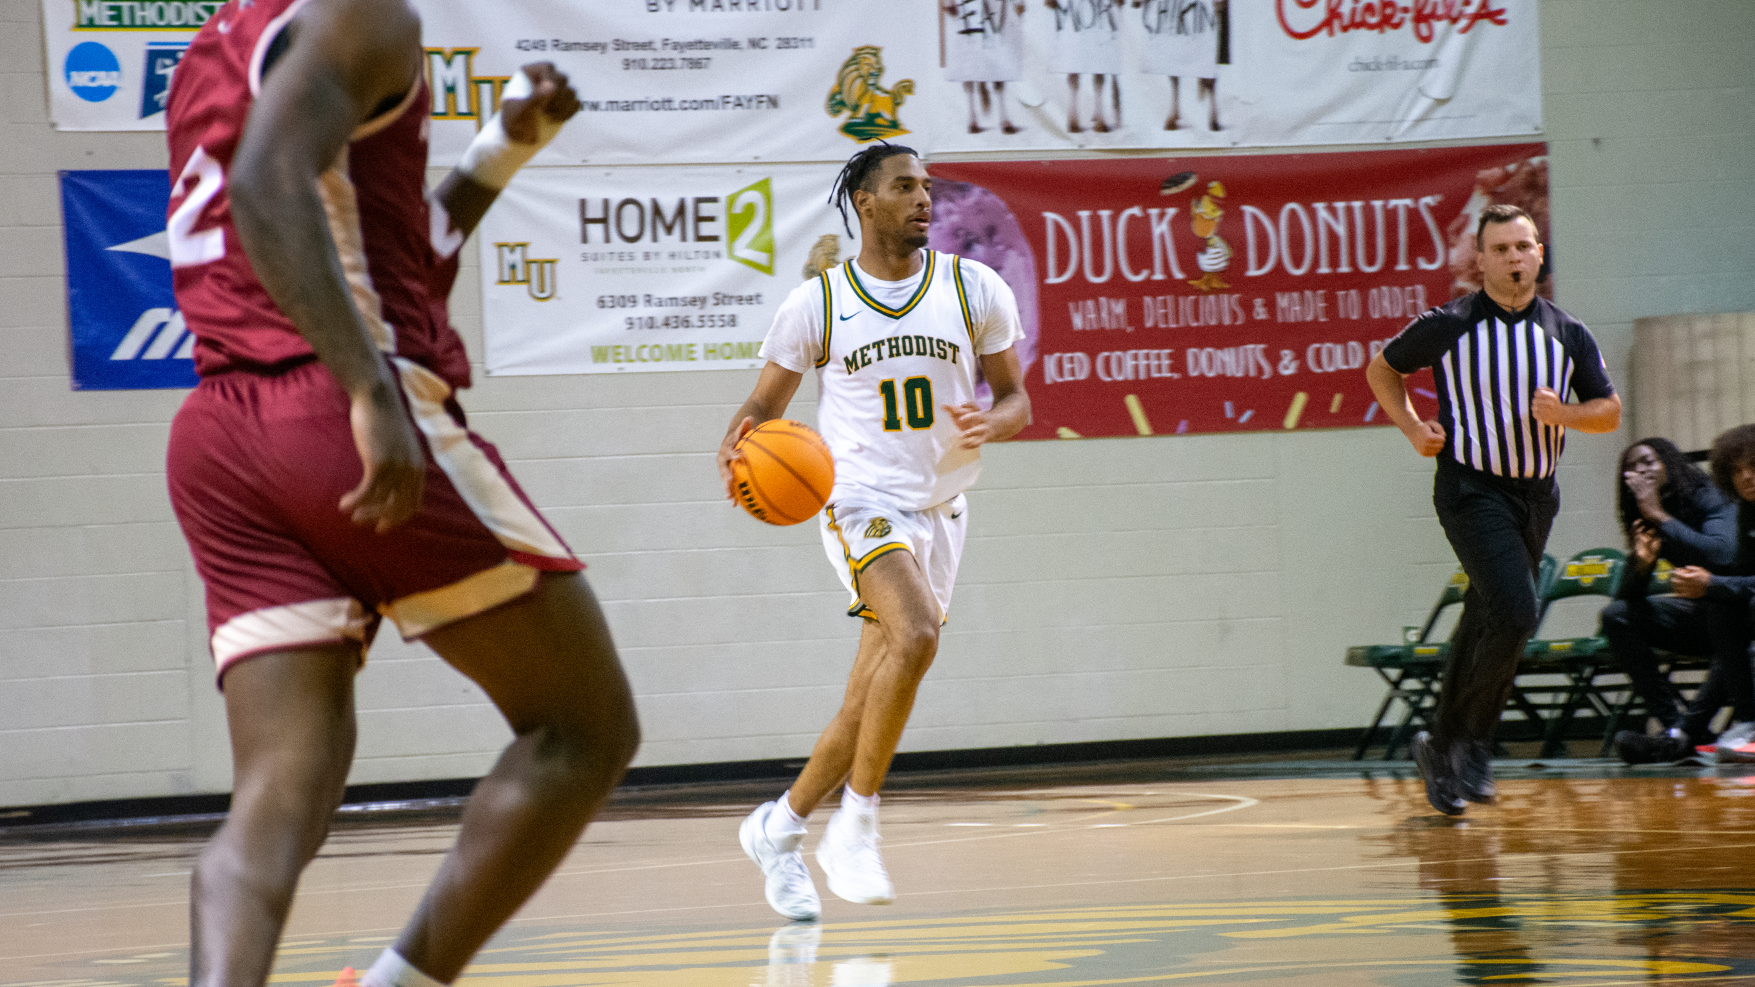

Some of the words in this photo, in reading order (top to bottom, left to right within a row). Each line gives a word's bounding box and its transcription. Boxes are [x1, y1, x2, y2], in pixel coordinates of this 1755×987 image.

[689, 0, 822, 12] MARRIOTT
[552, 39, 607, 54] Ramsey
[747, 37, 768, 50] NC
[167, 146, 226, 269] 2
[579, 197, 720, 244] HOME
[580, 251, 635, 261] SUITES
[668, 250, 721, 260] HILTON
[1042, 206, 1186, 283] DUCK
[1240, 195, 1446, 276] DONUTS
[493, 242, 559, 302] MU
[597, 295, 637, 309] 6309
[643, 293, 707, 309] Ramsey
[712, 292, 762, 306] Street
[1068, 297, 1135, 331] WARM,
[1143, 294, 1246, 328] DELICIOUS
[1253, 298, 1268, 320] &
[1275, 290, 1329, 322] MADE
[1336, 289, 1362, 319] TO
[591, 343, 697, 363] WELCOME
[843, 335, 960, 375] METHODIST
[1044, 351, 1091, 384] ICED
[1187, 344, 1272, 379] DONUTS
[1278, 350, 1299, 375] &
[1306, 341, 1364, 372] COLD
[878, 375, 935, 432] 10
